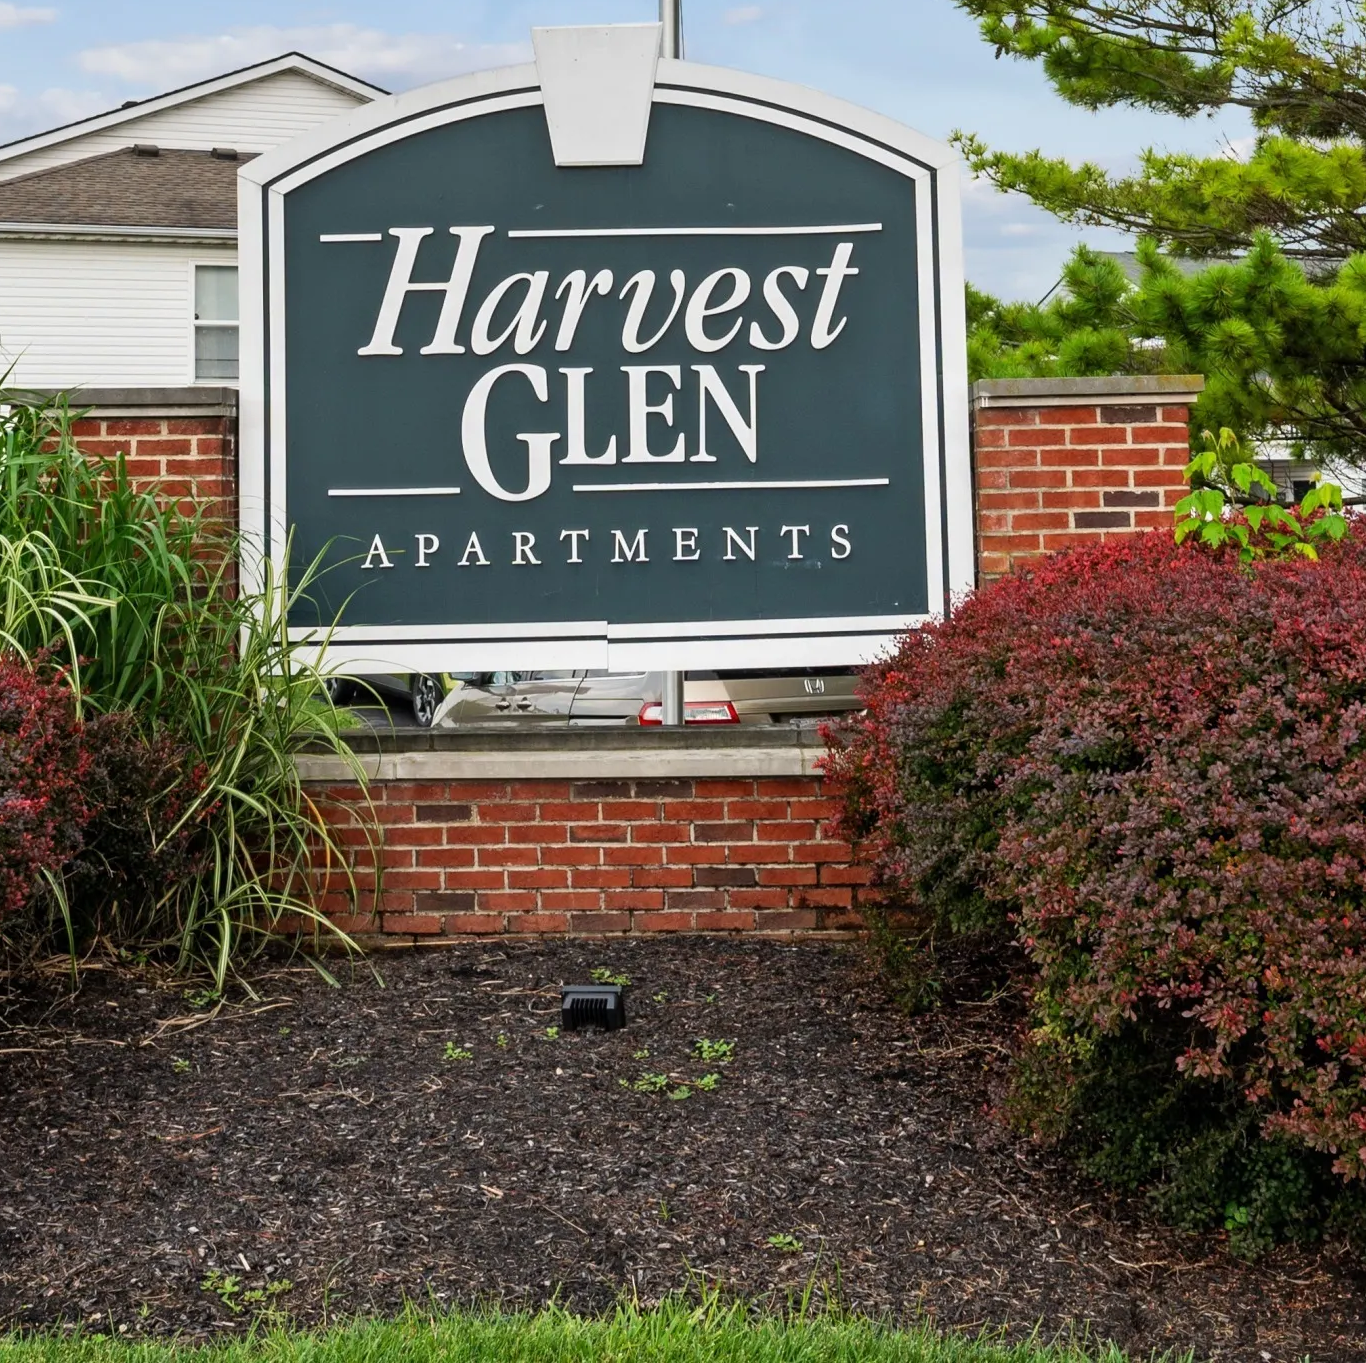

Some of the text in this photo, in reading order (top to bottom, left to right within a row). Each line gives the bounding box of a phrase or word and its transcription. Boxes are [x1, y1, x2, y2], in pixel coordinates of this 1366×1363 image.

[357, 225, 860, 356] Harvest
[461, 363, 766, 502] GLEN
[360, 524, 852, 569] APARTMENTS
